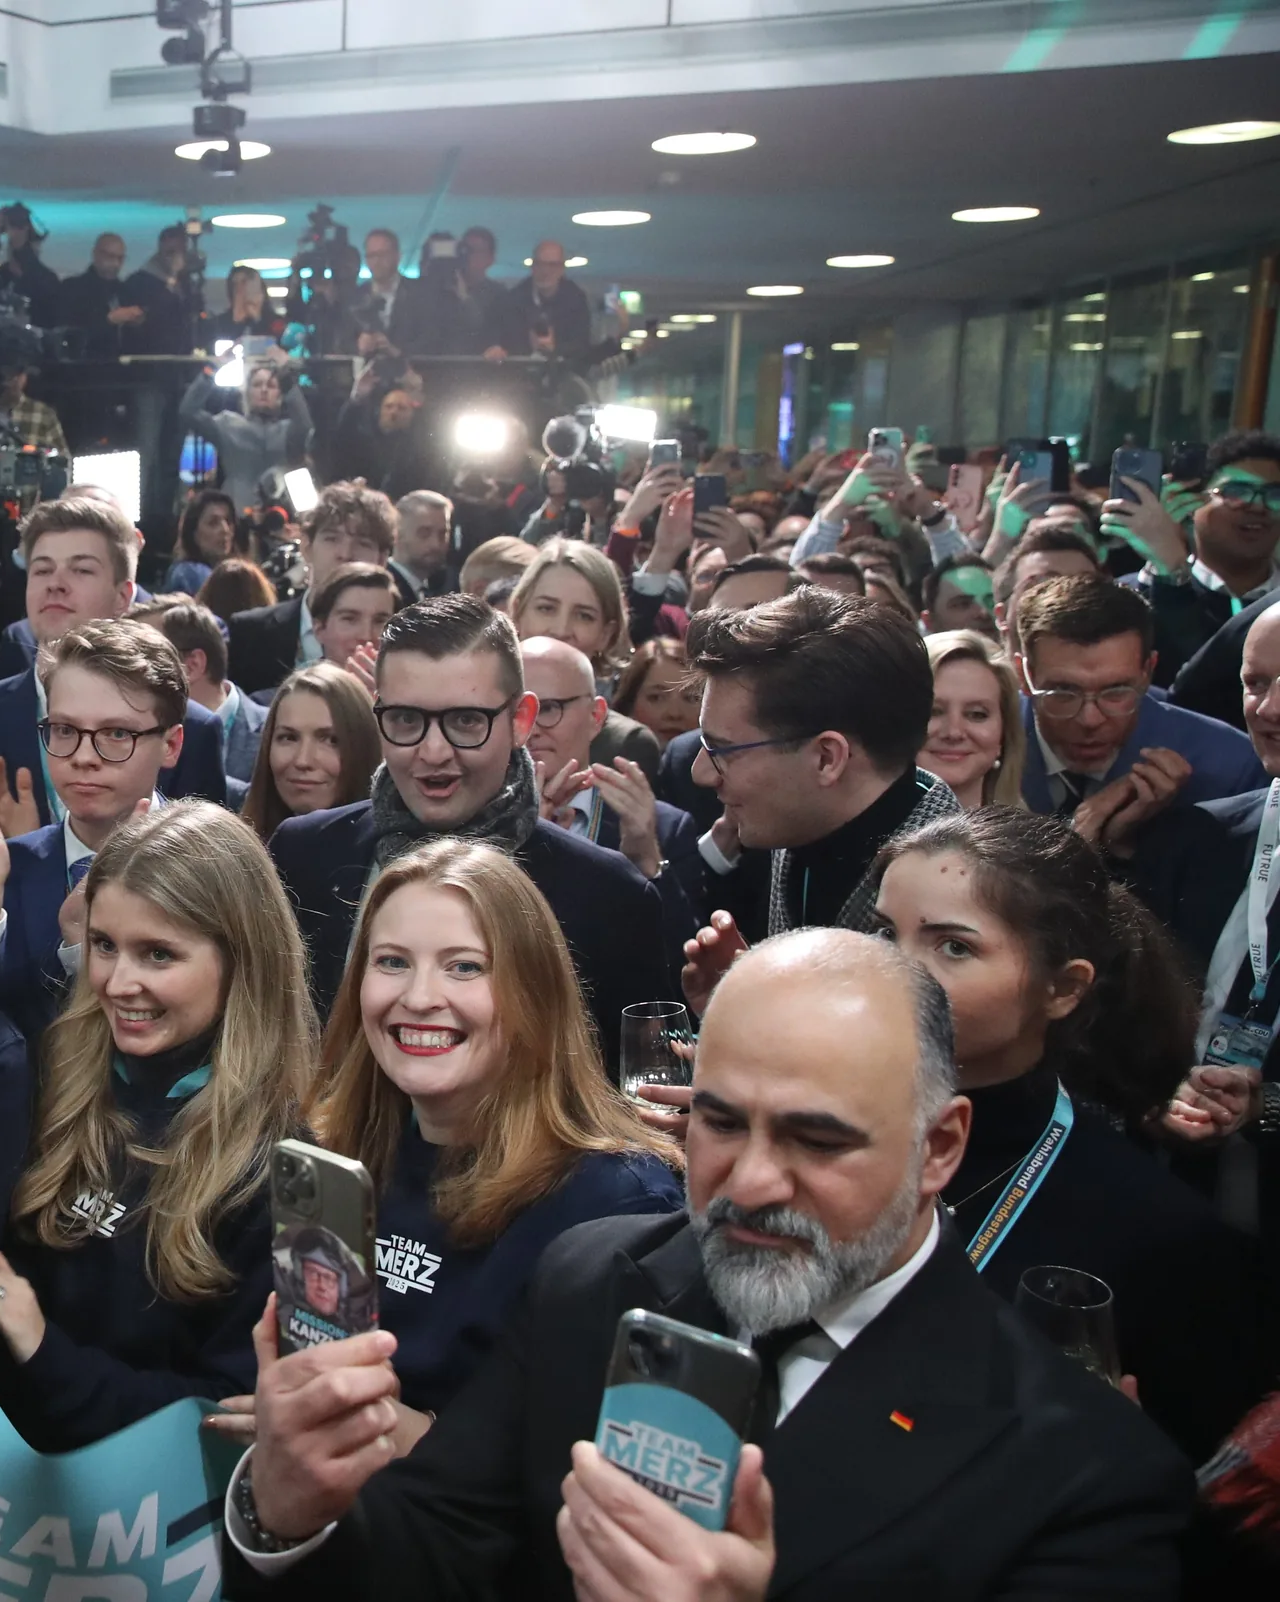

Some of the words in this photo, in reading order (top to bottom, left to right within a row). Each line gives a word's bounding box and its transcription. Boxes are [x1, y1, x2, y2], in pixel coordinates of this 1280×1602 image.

[1257, 844, 1273, 882] FUTRUE
[1251, 943, 1261, 982] UTRUE
[1017, 1126, 1063, 1189] Wahlabend
[391, 1234, 427, 1256] TEAM
[374, 1244, 440, 1288] MERZ
[636, 1427, 696, 1458] TEAM
[604, 1431, 720, 1496] MERZ
